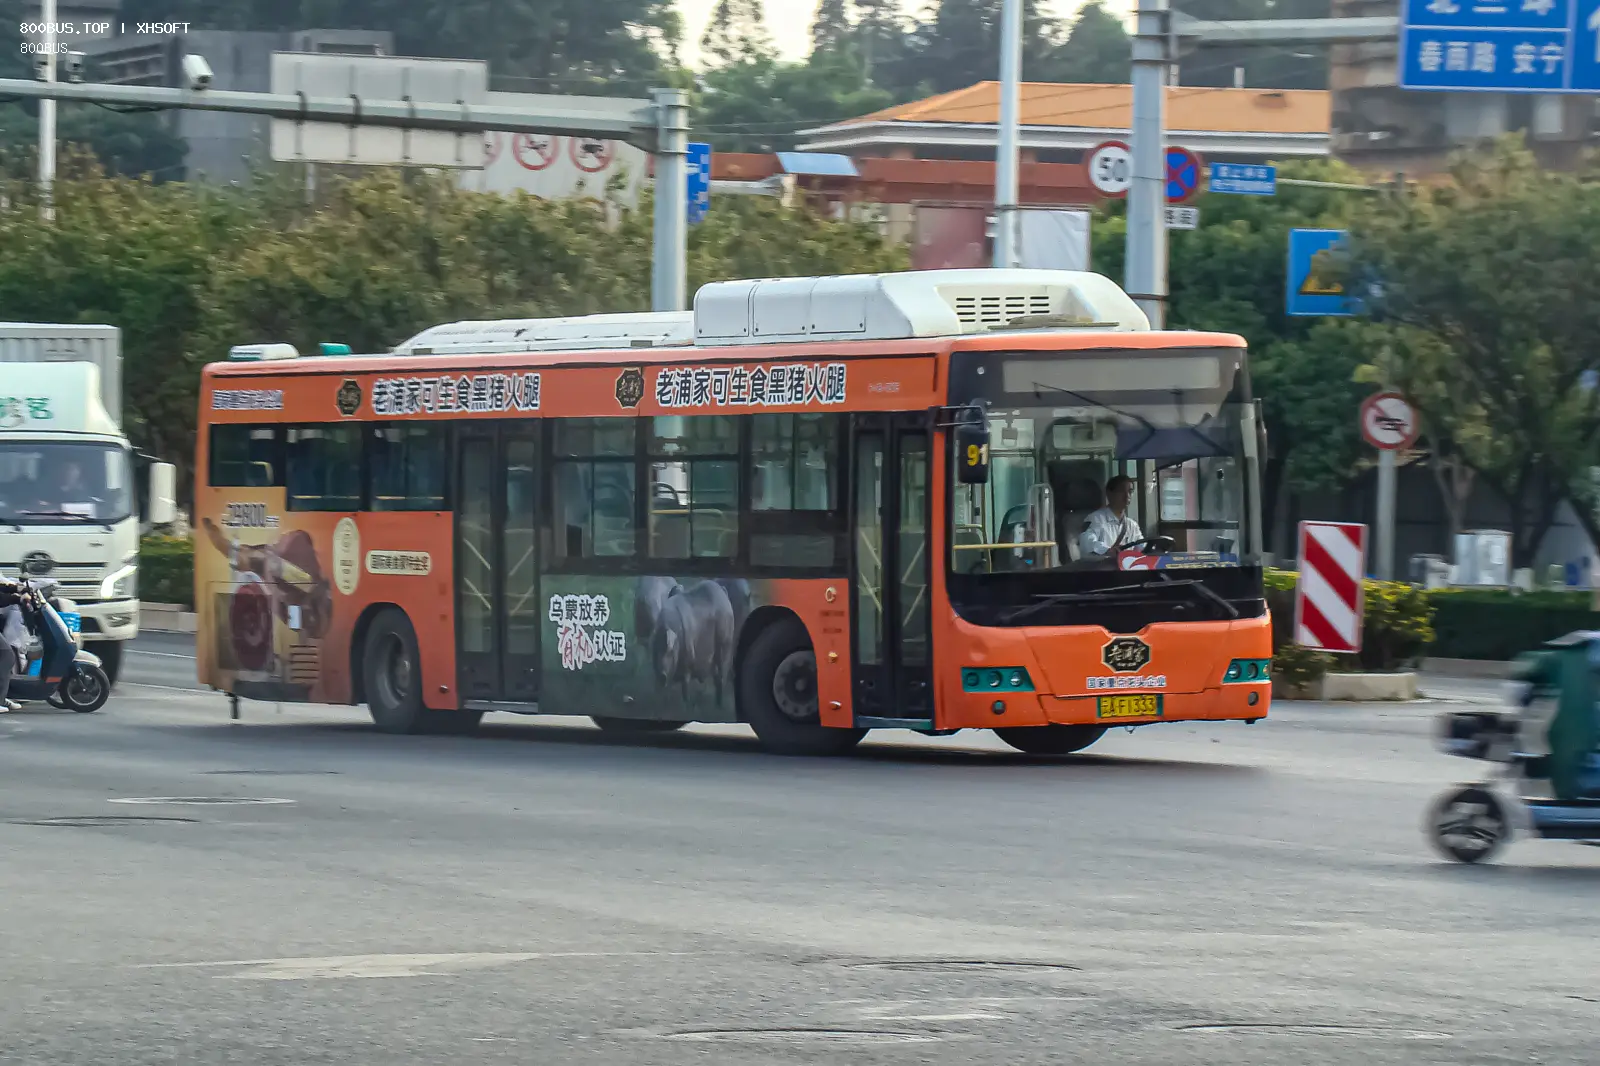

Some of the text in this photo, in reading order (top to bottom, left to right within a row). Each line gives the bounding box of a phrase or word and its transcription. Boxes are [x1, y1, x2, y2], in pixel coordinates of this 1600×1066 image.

[1099, 156, 1129, 183] 50
[656, 363, 847, 407] 老浦家可生食黑猪火腿
[967, 444, 989, 467] 91
[550, 595, 610, 626] 乌蒙放养
[558, 624, 626, 670] 有机认证
